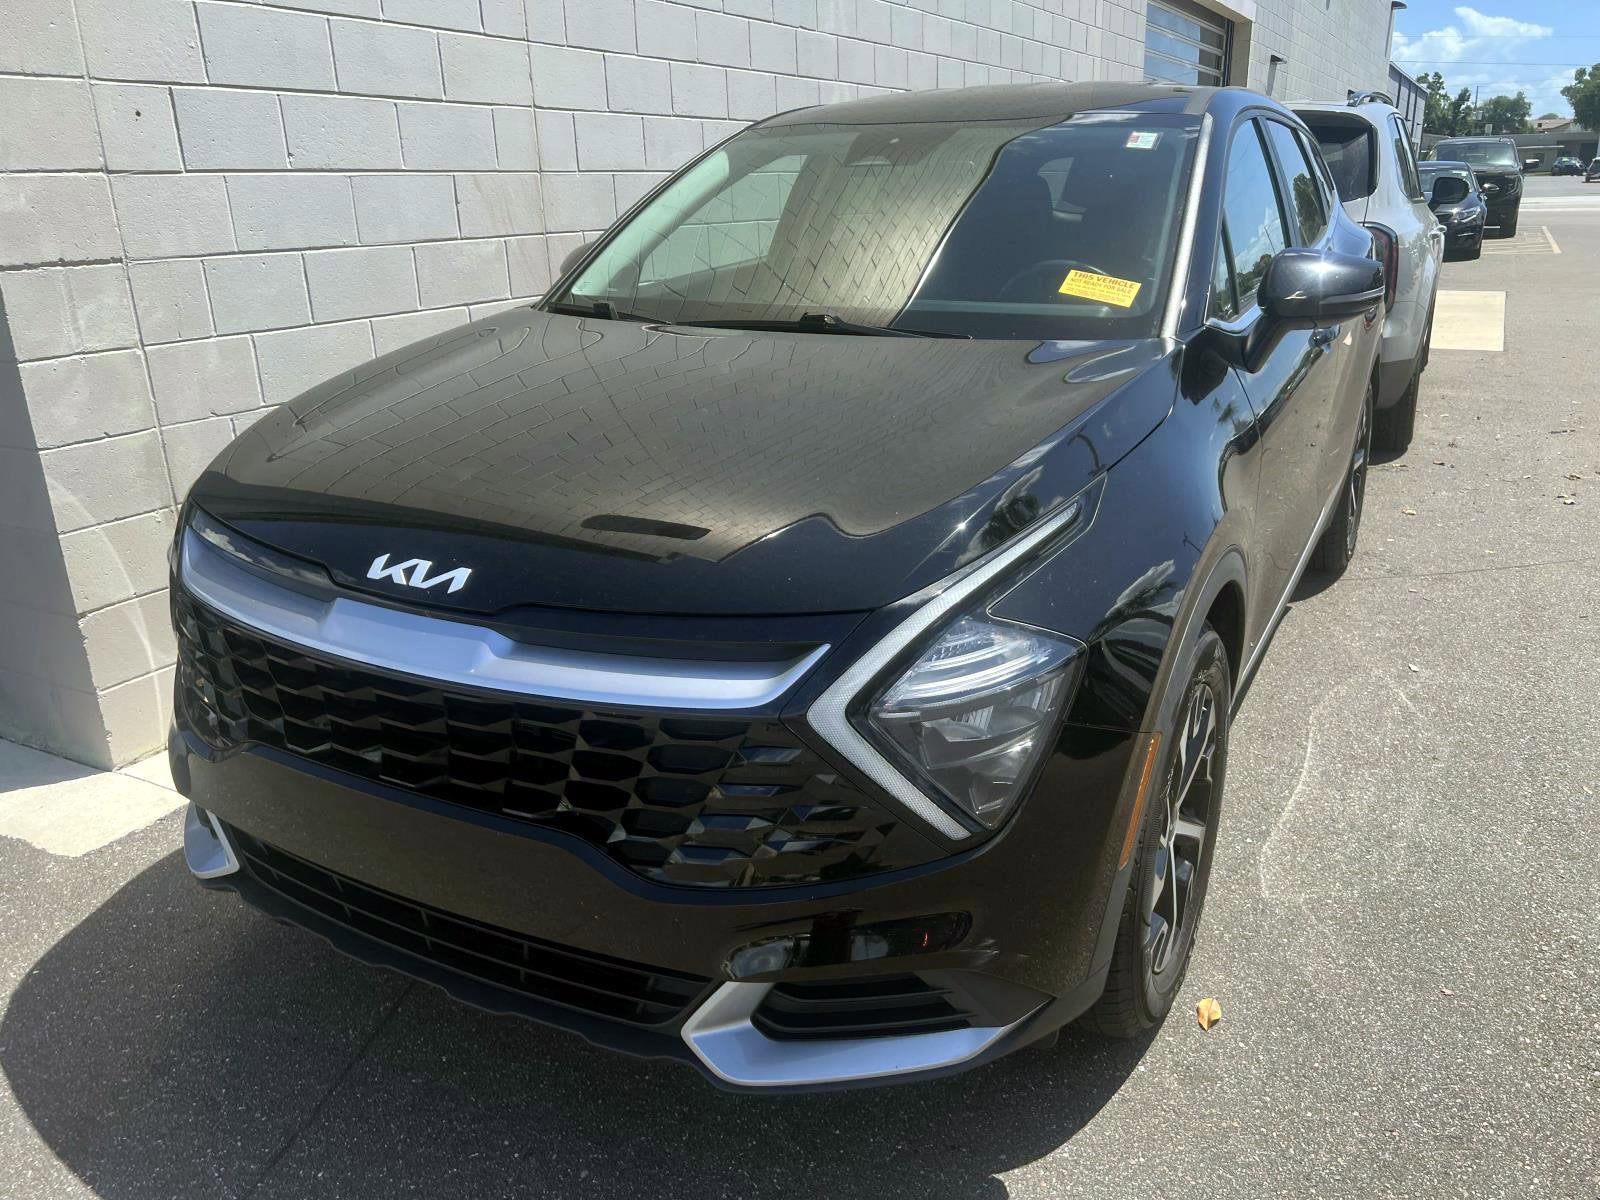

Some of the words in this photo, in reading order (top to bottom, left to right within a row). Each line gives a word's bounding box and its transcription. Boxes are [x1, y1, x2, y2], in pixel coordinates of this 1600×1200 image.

[1073, 271, 1095, 280] THIS
[1097, 275, 1136, 289] VEHICLE
[1084, 279, 1103, 287] READY
[1116, 286, 1132, 294] SALE
